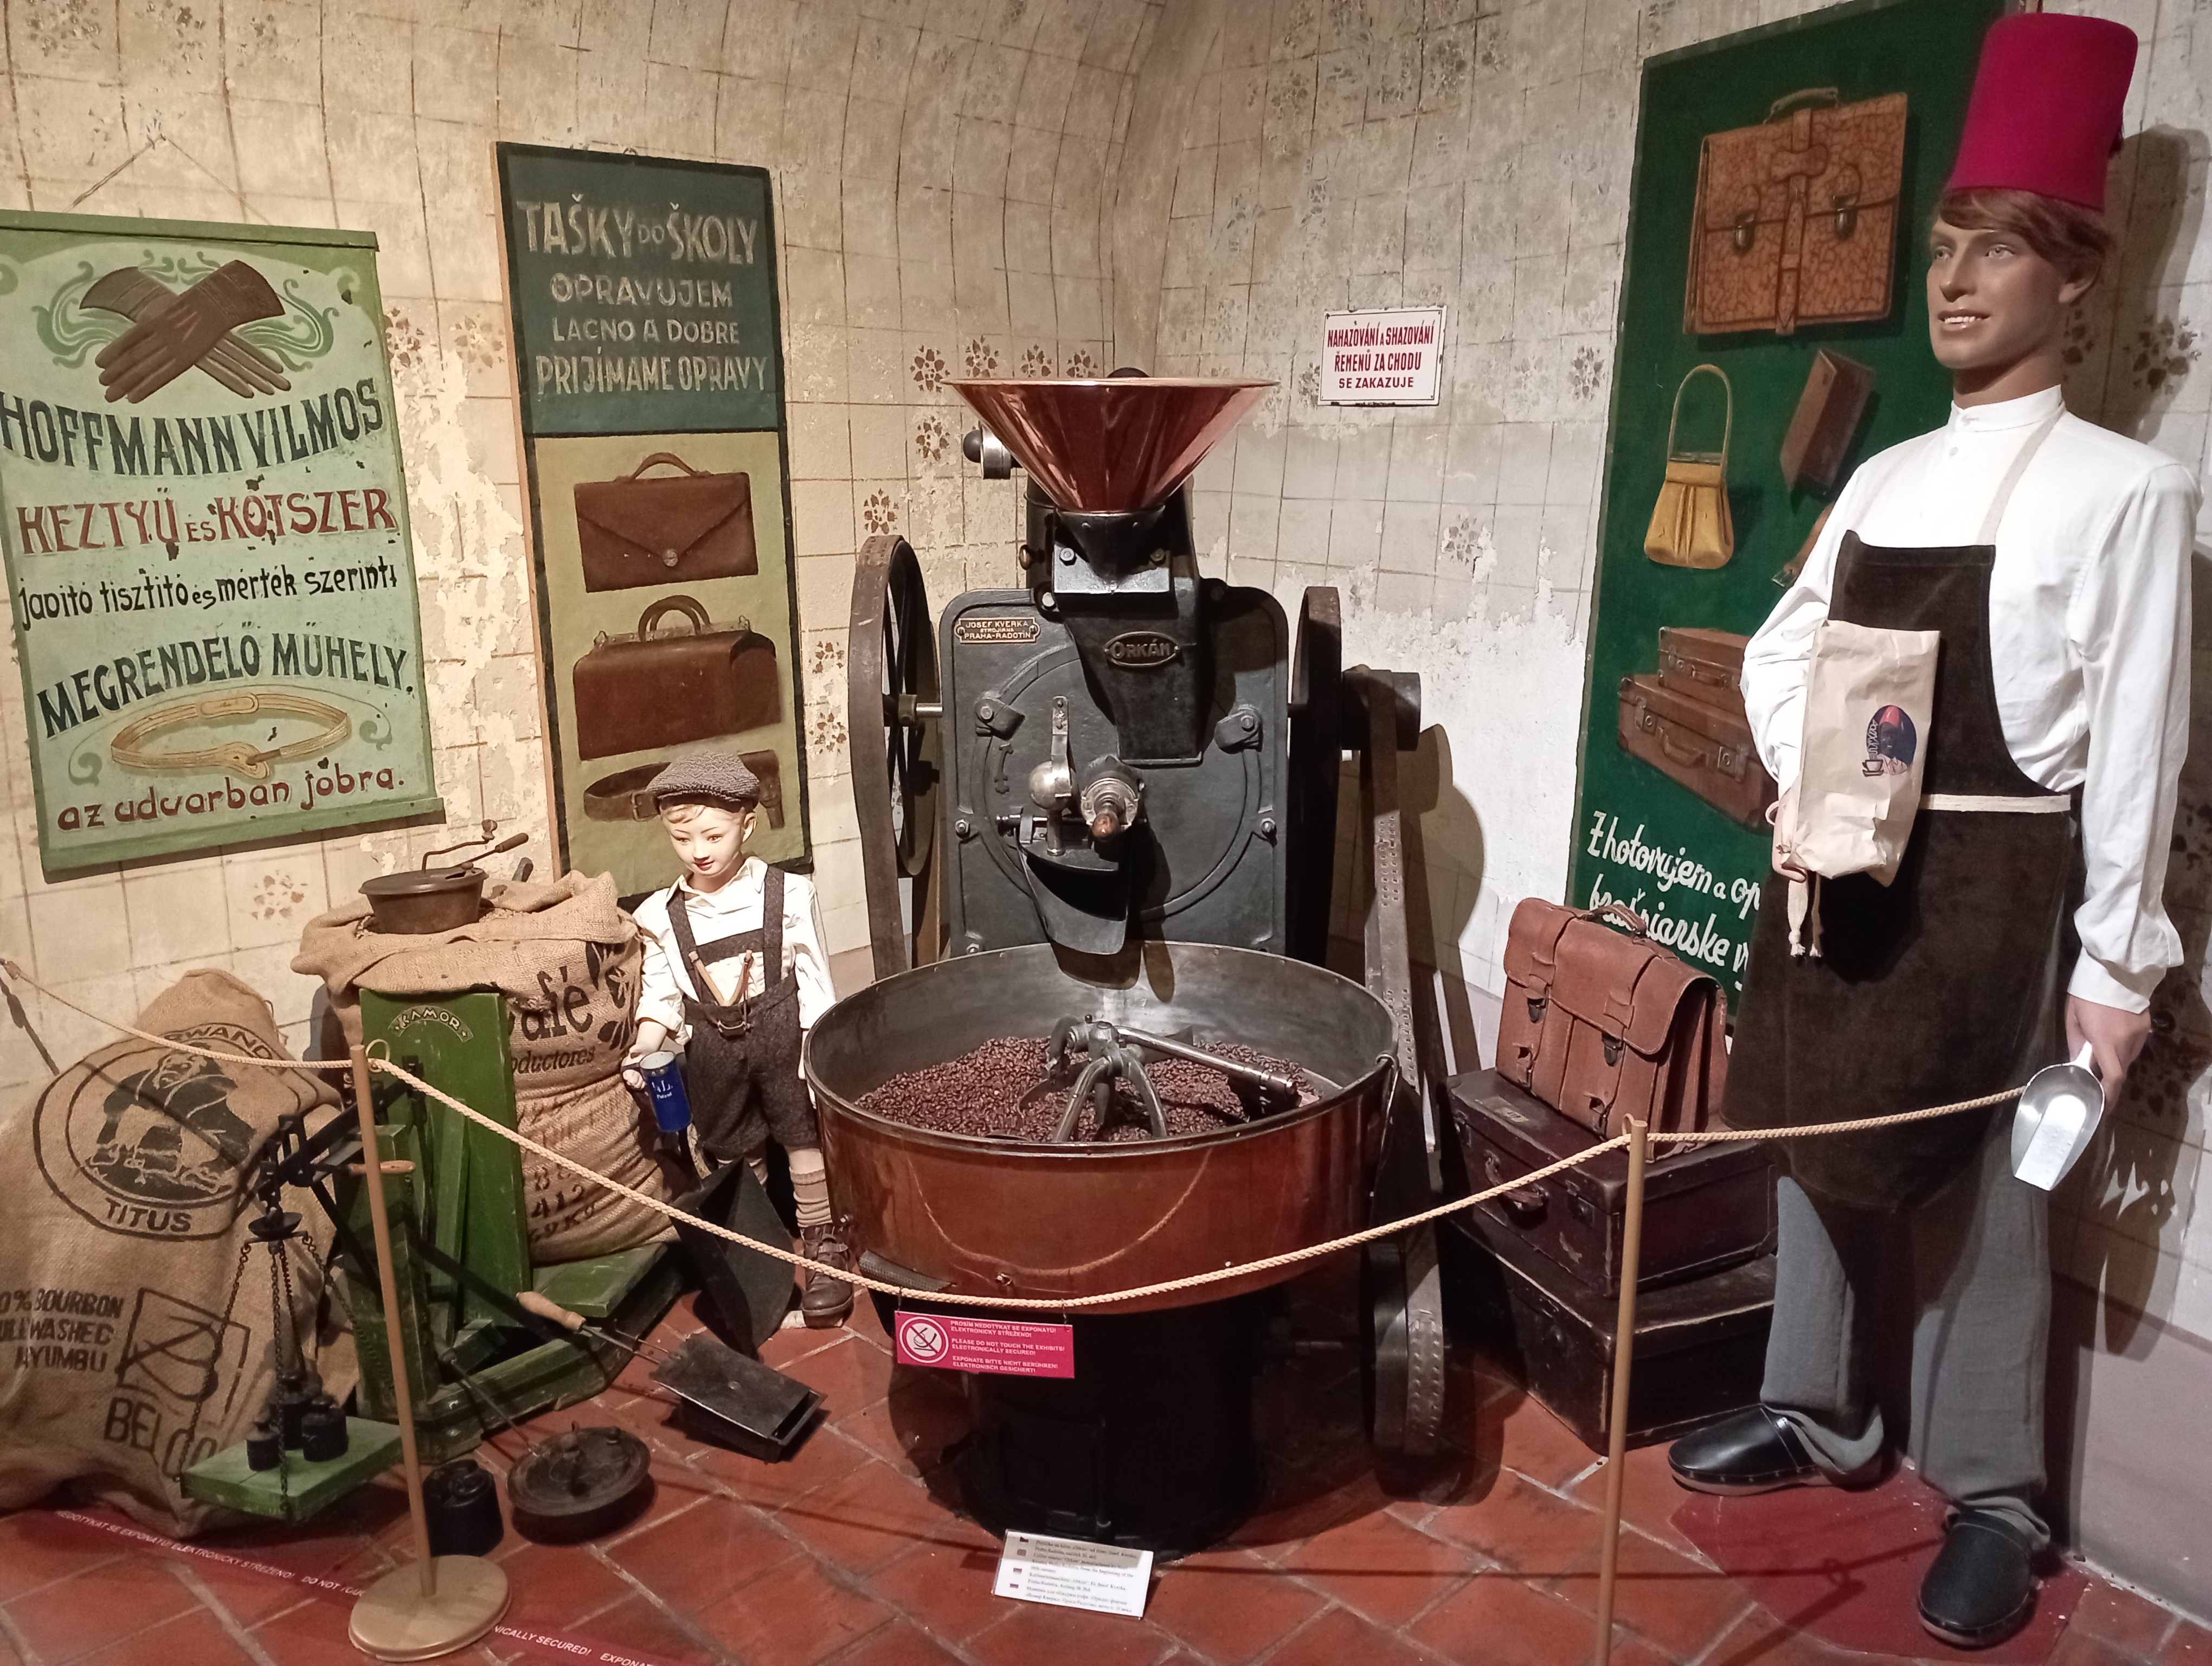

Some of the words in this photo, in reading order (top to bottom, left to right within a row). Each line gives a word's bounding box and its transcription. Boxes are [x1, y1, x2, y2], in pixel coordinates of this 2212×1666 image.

[517, 193, 636, 259] TAŠKY
[638, 223, 664, 245] DO
[666, 201, 757, 264] ŠKOLY
[550, 273, 733, 307] OPRAVUJEM
[552, 317, 636, 342] LACNO
[643, 319, 659, 342] A
[667, 319, 740, 343] DOBRE
[1328, 322, 1380, 347] NAHAZOVÁNÍ
[1386, 319, 1435, 345] SHAZOVÁNÍ
[536, 347, 673, 395] PRIJÍMAME
[678, 356, 768, 391] OPRAVY
[1335, 349, 1371, 372] ŘEMENŮ
[1374, 354, 1385, 371] ZA
[1388, 352, 1422, 370] CHODU
[1339, 378, 1352, 388] SE
[1355, 377, 1413, 388] ZAKAZUJE
[0, 391, 242, 476] HOFFMANN
[242, 378, 384, 469] VILMOS
[1110, 638, 1170, 659] ORKÁN
[57, 804, 105, 831] az
[1713, 882, 1726, 899] a
[398, 1008, 460, 1030] KAMOR
[106, 1197, 192, 1232] TITUS
[951, 1326, 996, 1335] ELEKTRONICKY
[952, 1344, 1004, 1353] ELECTRONICALLY
[953, 1355, 983, 1363] EXPONATE
[953, 1361, 998, 1370] ELEKTRONISCH
[171, 1543, 243, 1565] ELEKTRONICKY
[301, 1576, 318, 1584] DO
[318, 1580, 341, 1590] NOT
[536, 1636, 592, 1656] SECURED!
